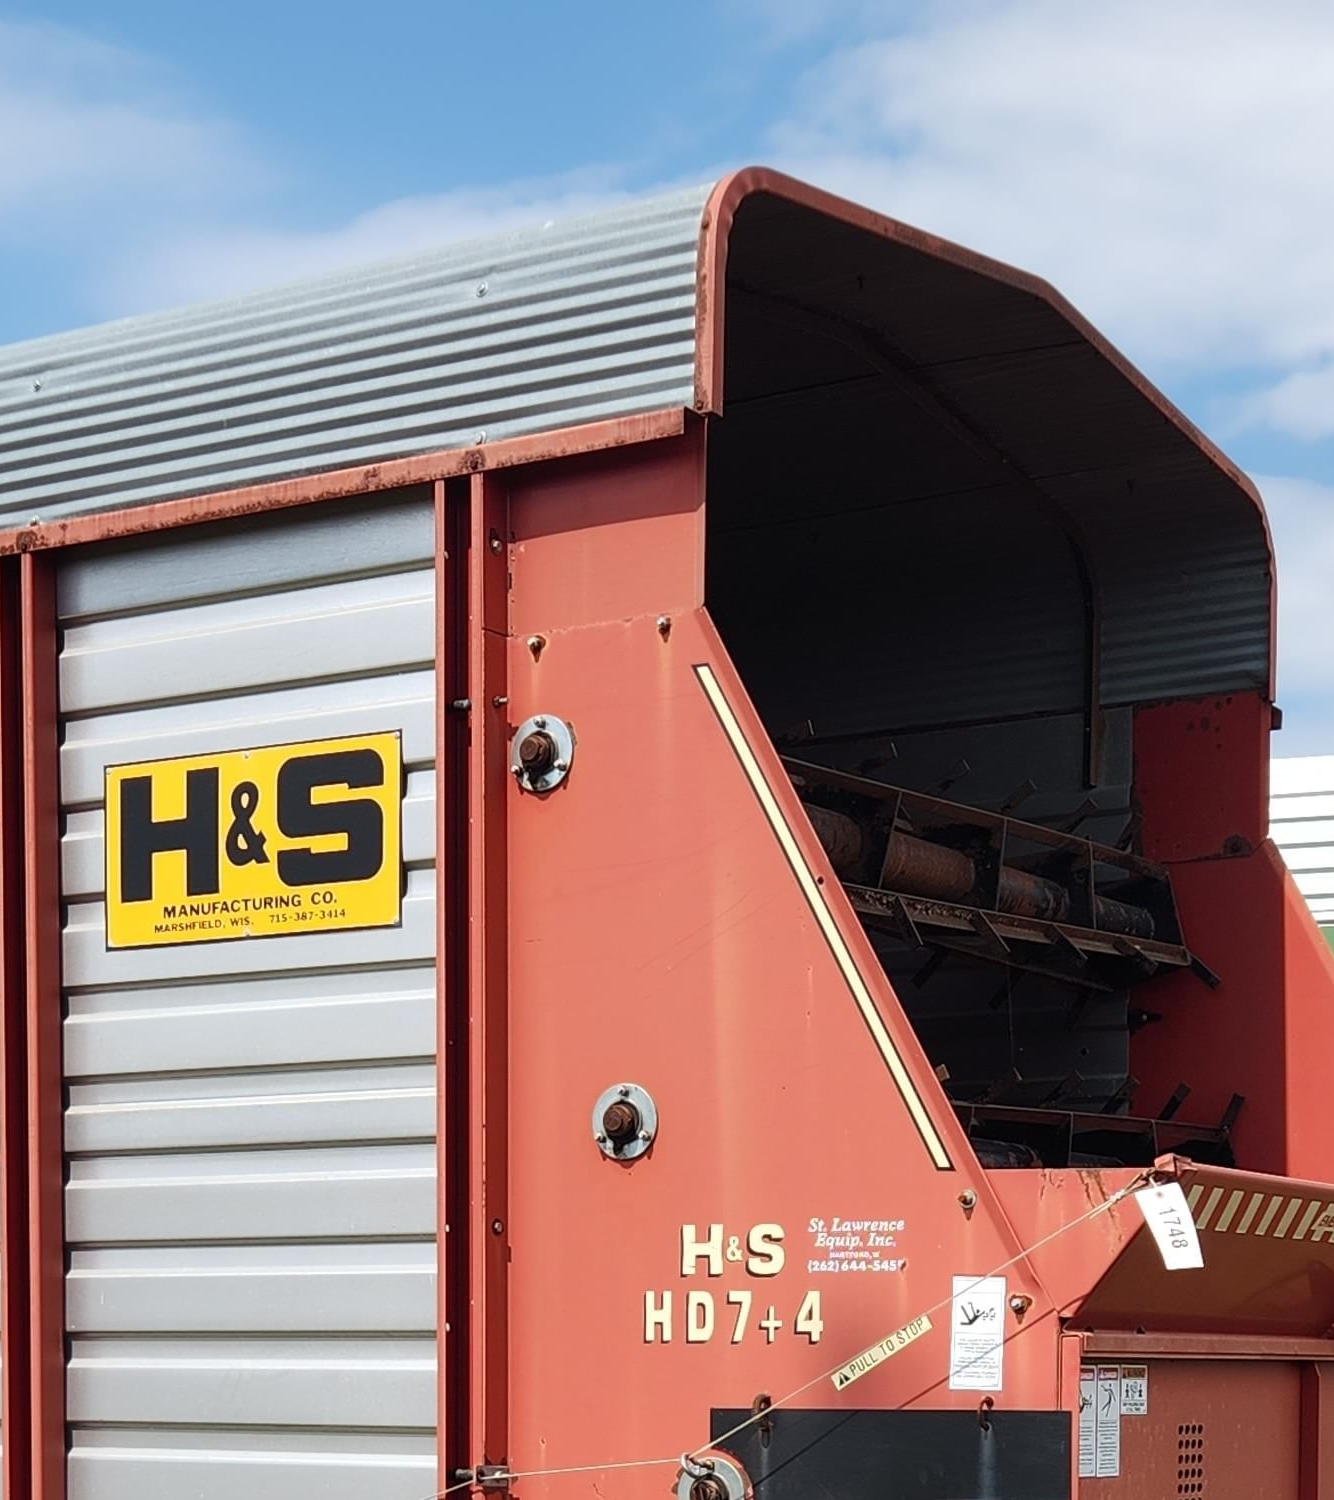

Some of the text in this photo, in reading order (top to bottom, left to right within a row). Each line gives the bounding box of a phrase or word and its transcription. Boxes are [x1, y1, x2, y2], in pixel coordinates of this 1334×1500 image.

[120, 749, 384, 904] H&S
[163, 891, 337, 919] MANUFACTURING CO.
[154, 908, 346, 934] MARSHFIELD, WIS. 715-387-3414
[808, 1217, 905, 1232] St. Lawrence
[1159, 1207, 1189, 1248] 1748
[680, 1223, 785, 1277] H&S
[814, 1232, 897, 1250] Equip. Inc.
[808, 1260, 839, 1273] (262)
[849, 1317, 925, 1377] PULL TO STOP
